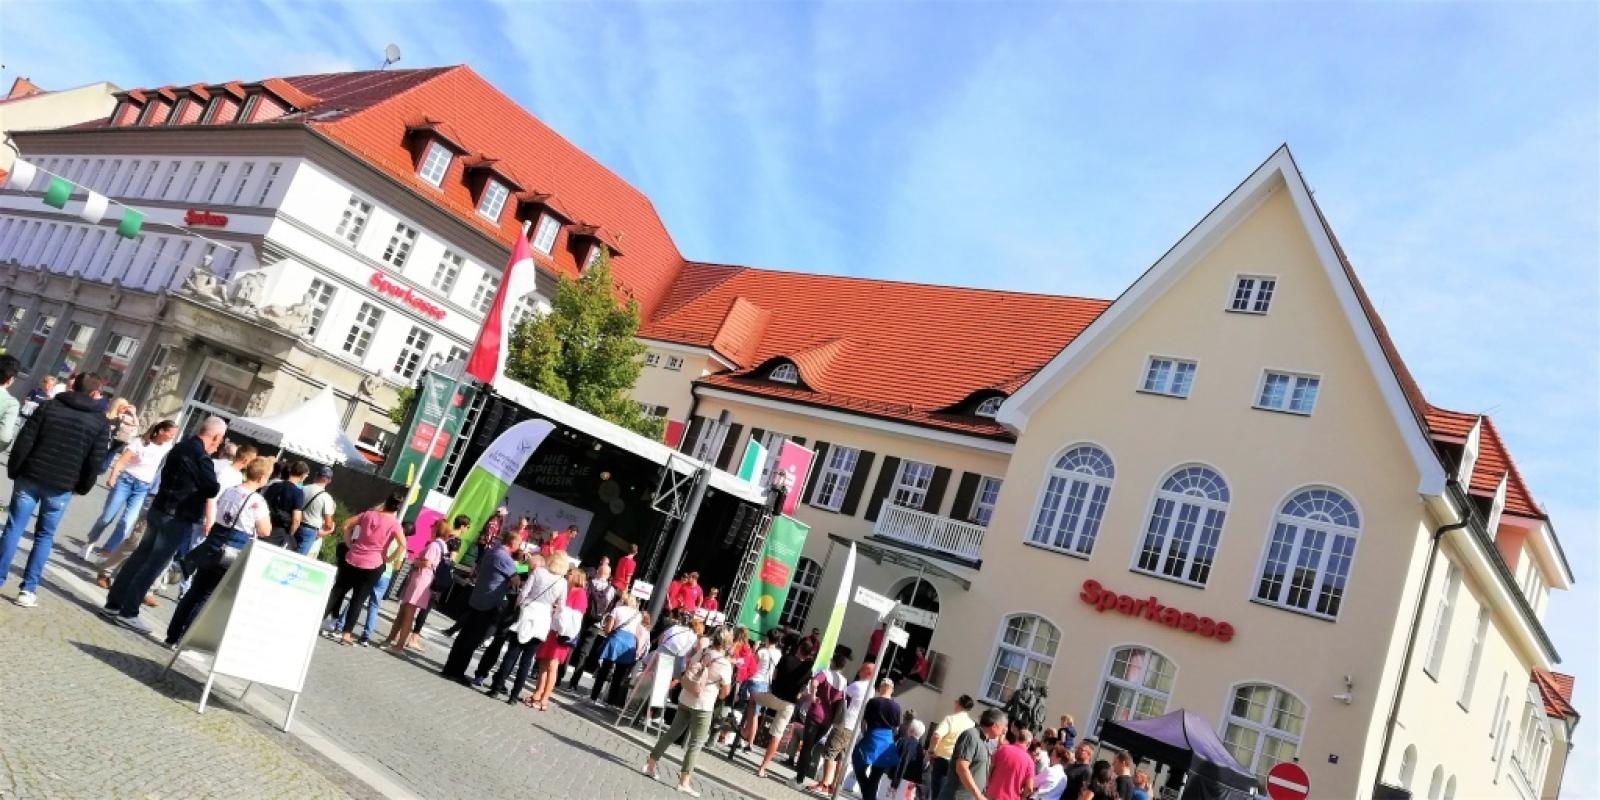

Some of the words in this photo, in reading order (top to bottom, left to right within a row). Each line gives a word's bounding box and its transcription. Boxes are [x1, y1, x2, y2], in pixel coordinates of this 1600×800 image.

[369, 270, 447, 320] Sparkasse
[527, 463, 568, 475] SPIELT
[535, 475, 575, 487] MUSIK
[1079, 579, 1234, 643] Sparkasse
